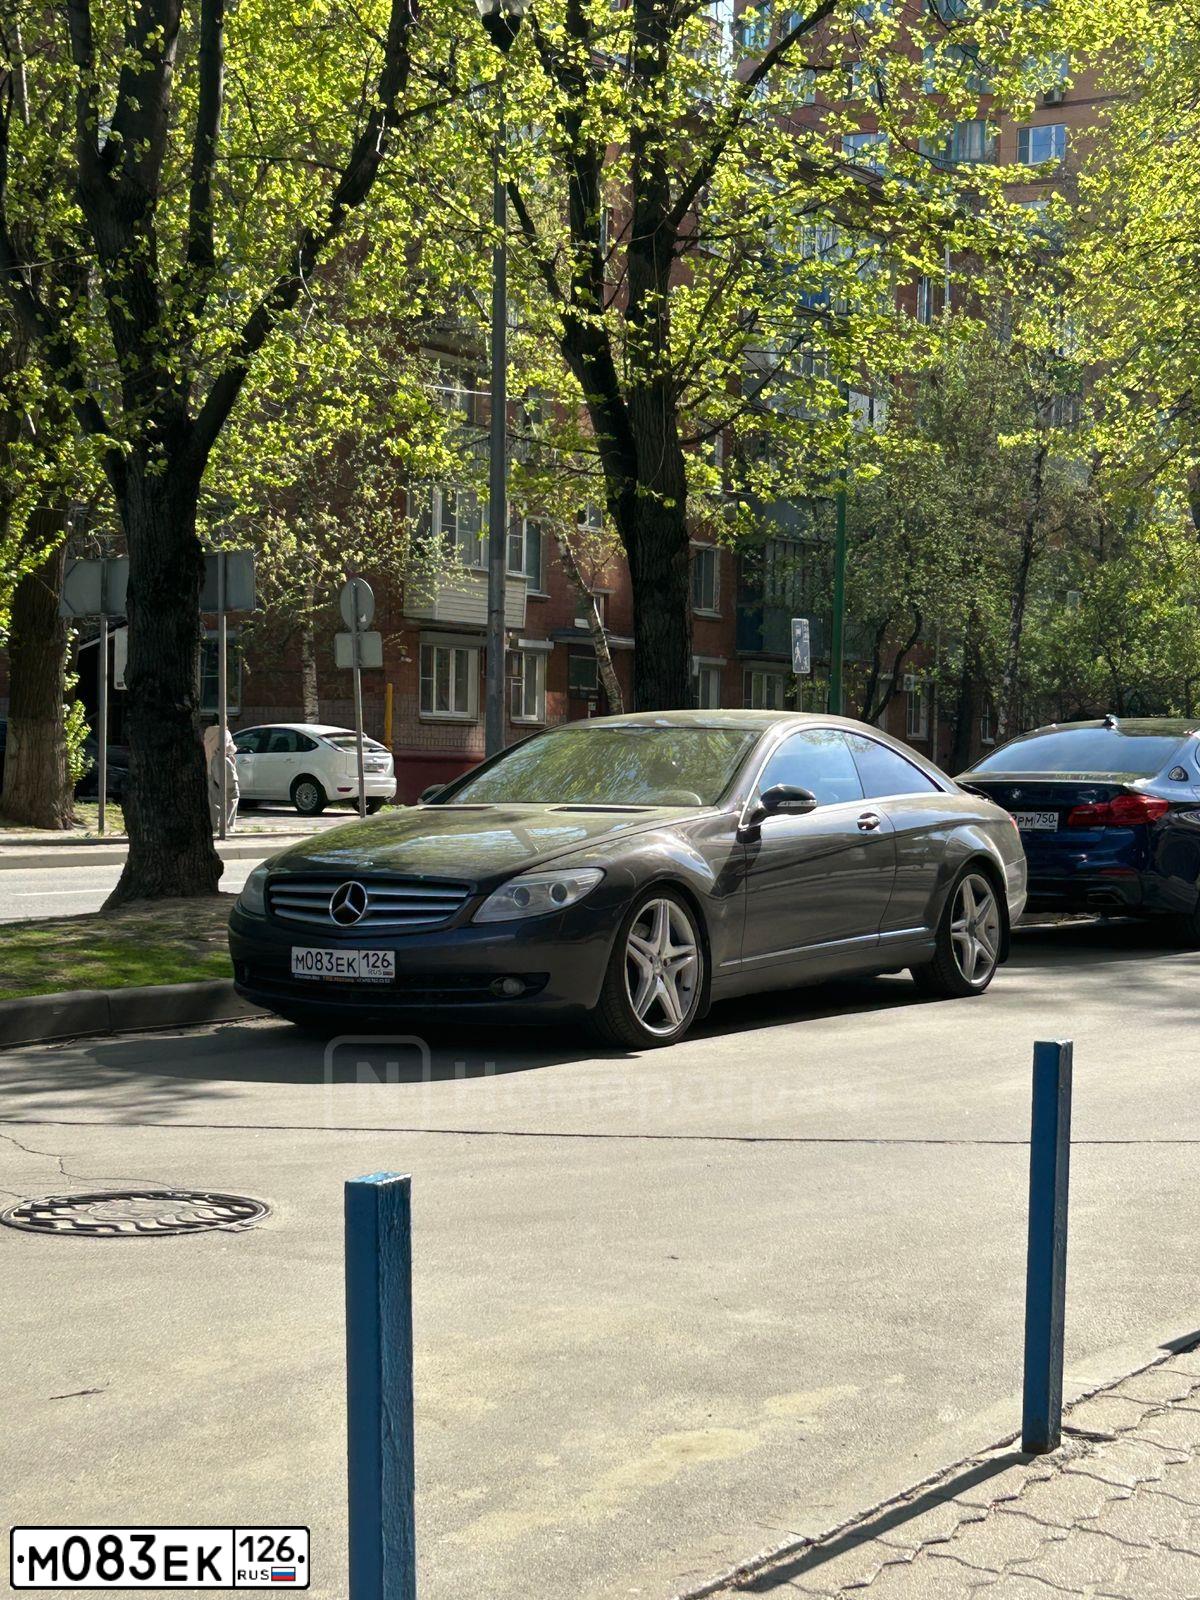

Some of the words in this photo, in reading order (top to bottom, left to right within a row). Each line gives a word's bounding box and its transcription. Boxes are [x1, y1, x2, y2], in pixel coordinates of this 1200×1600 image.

[1036, 813, 1055, 824] 750
[295, 951, 357, 974] М083ЕК
[362, 952, 392, 969] 126
